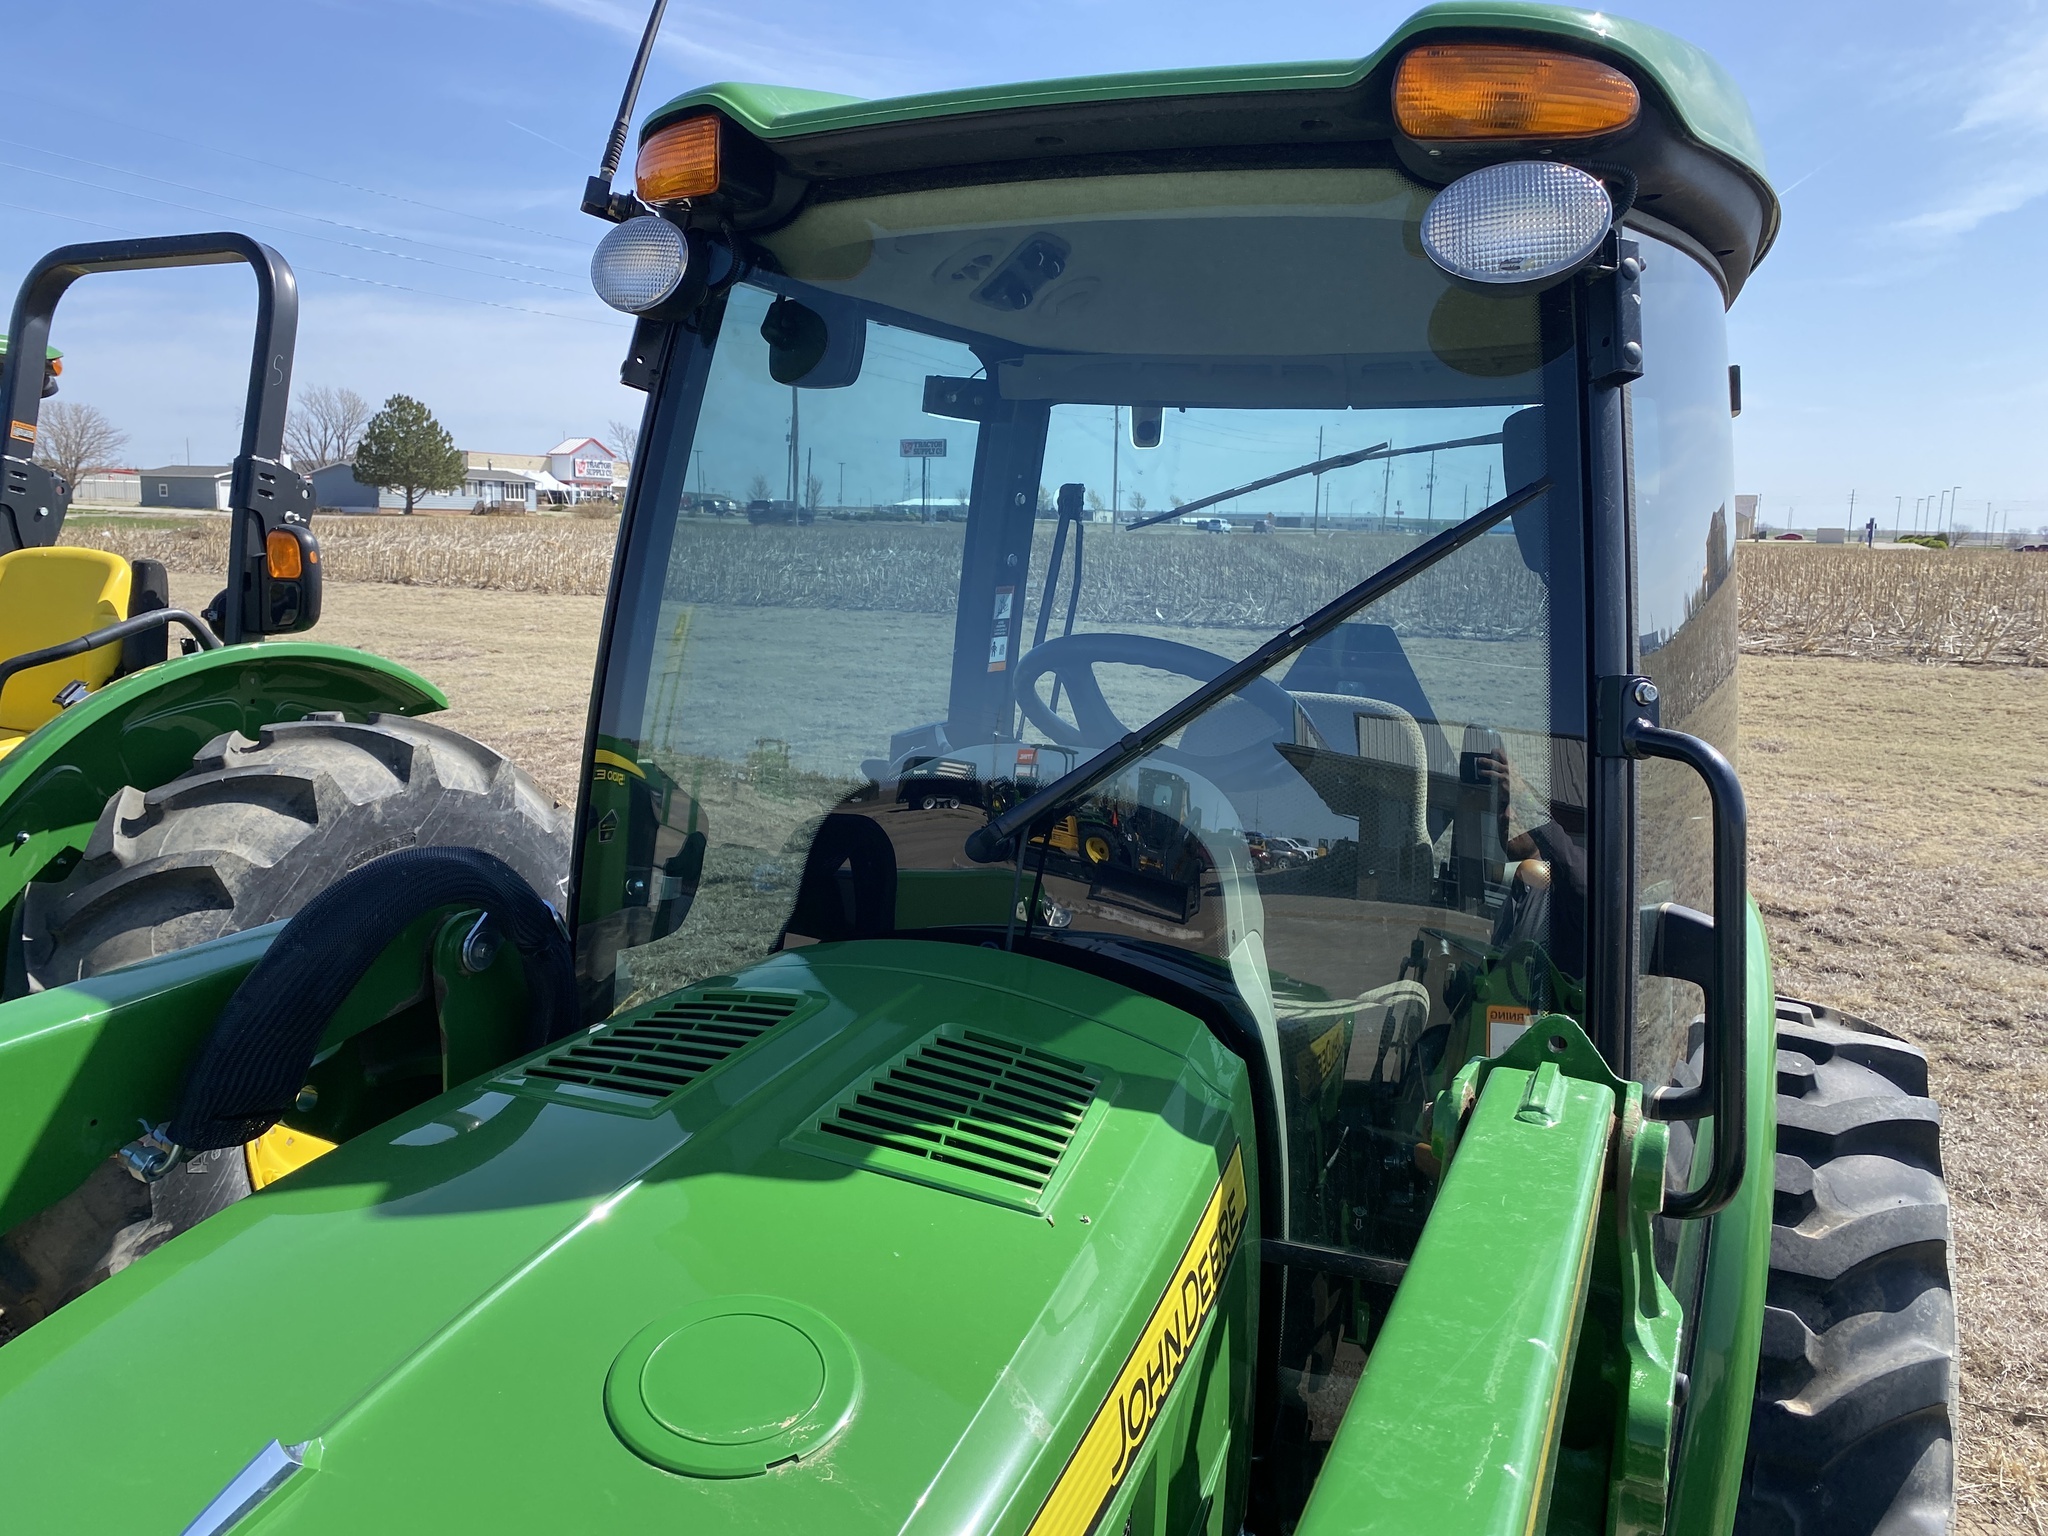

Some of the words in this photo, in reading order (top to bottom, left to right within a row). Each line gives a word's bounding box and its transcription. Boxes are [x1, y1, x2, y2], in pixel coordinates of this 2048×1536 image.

[913, 447, 935, 455] SUPPLY
[586, 461, 612, 469] TRACTOR
[1111, 1309, 1182, 1476] JOHN
[1180, 1188, 1240, 1334] DEERE
